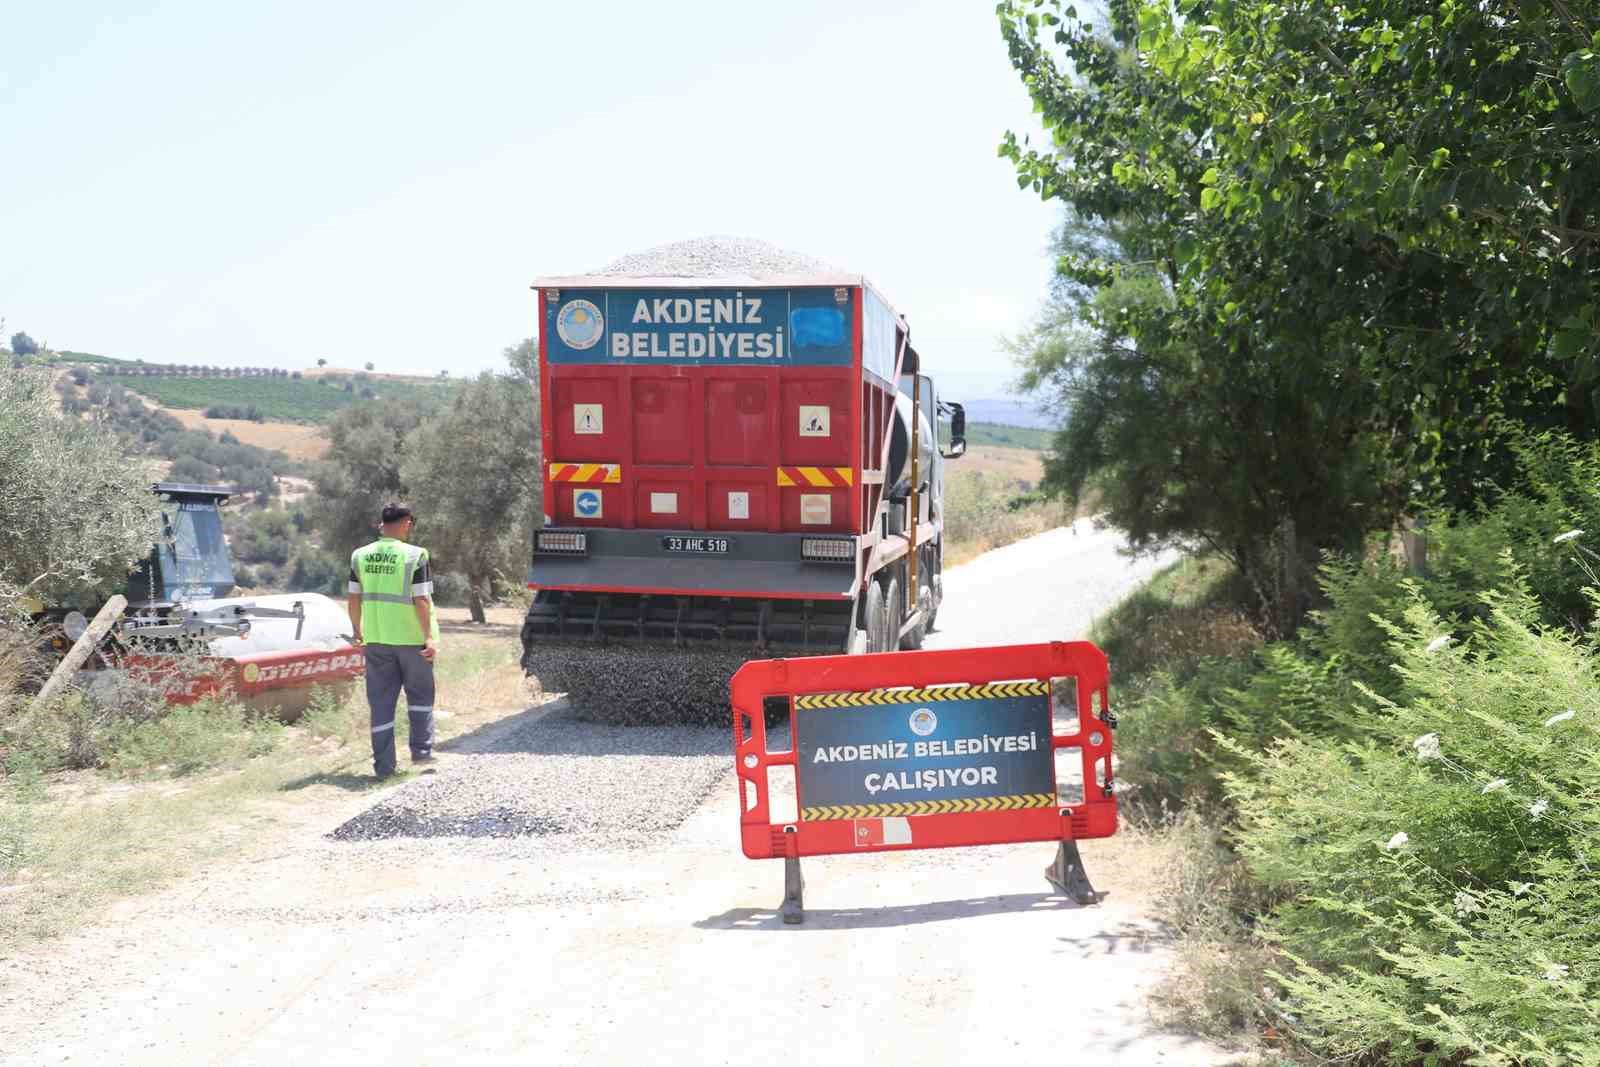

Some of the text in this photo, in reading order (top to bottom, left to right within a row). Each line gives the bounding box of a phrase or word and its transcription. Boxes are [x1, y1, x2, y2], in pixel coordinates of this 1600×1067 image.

[632, 291, 763, 324] AKDENİZ
[612, 326, 784, 358] BELEDİYESİ
[669, 538, 728, 552] 33 AHC 518
[813, 731, 1037, 763] AKDENİZ BELEDİYESİ
[864, 766, 998, 795] ÇALIŞIYOR
